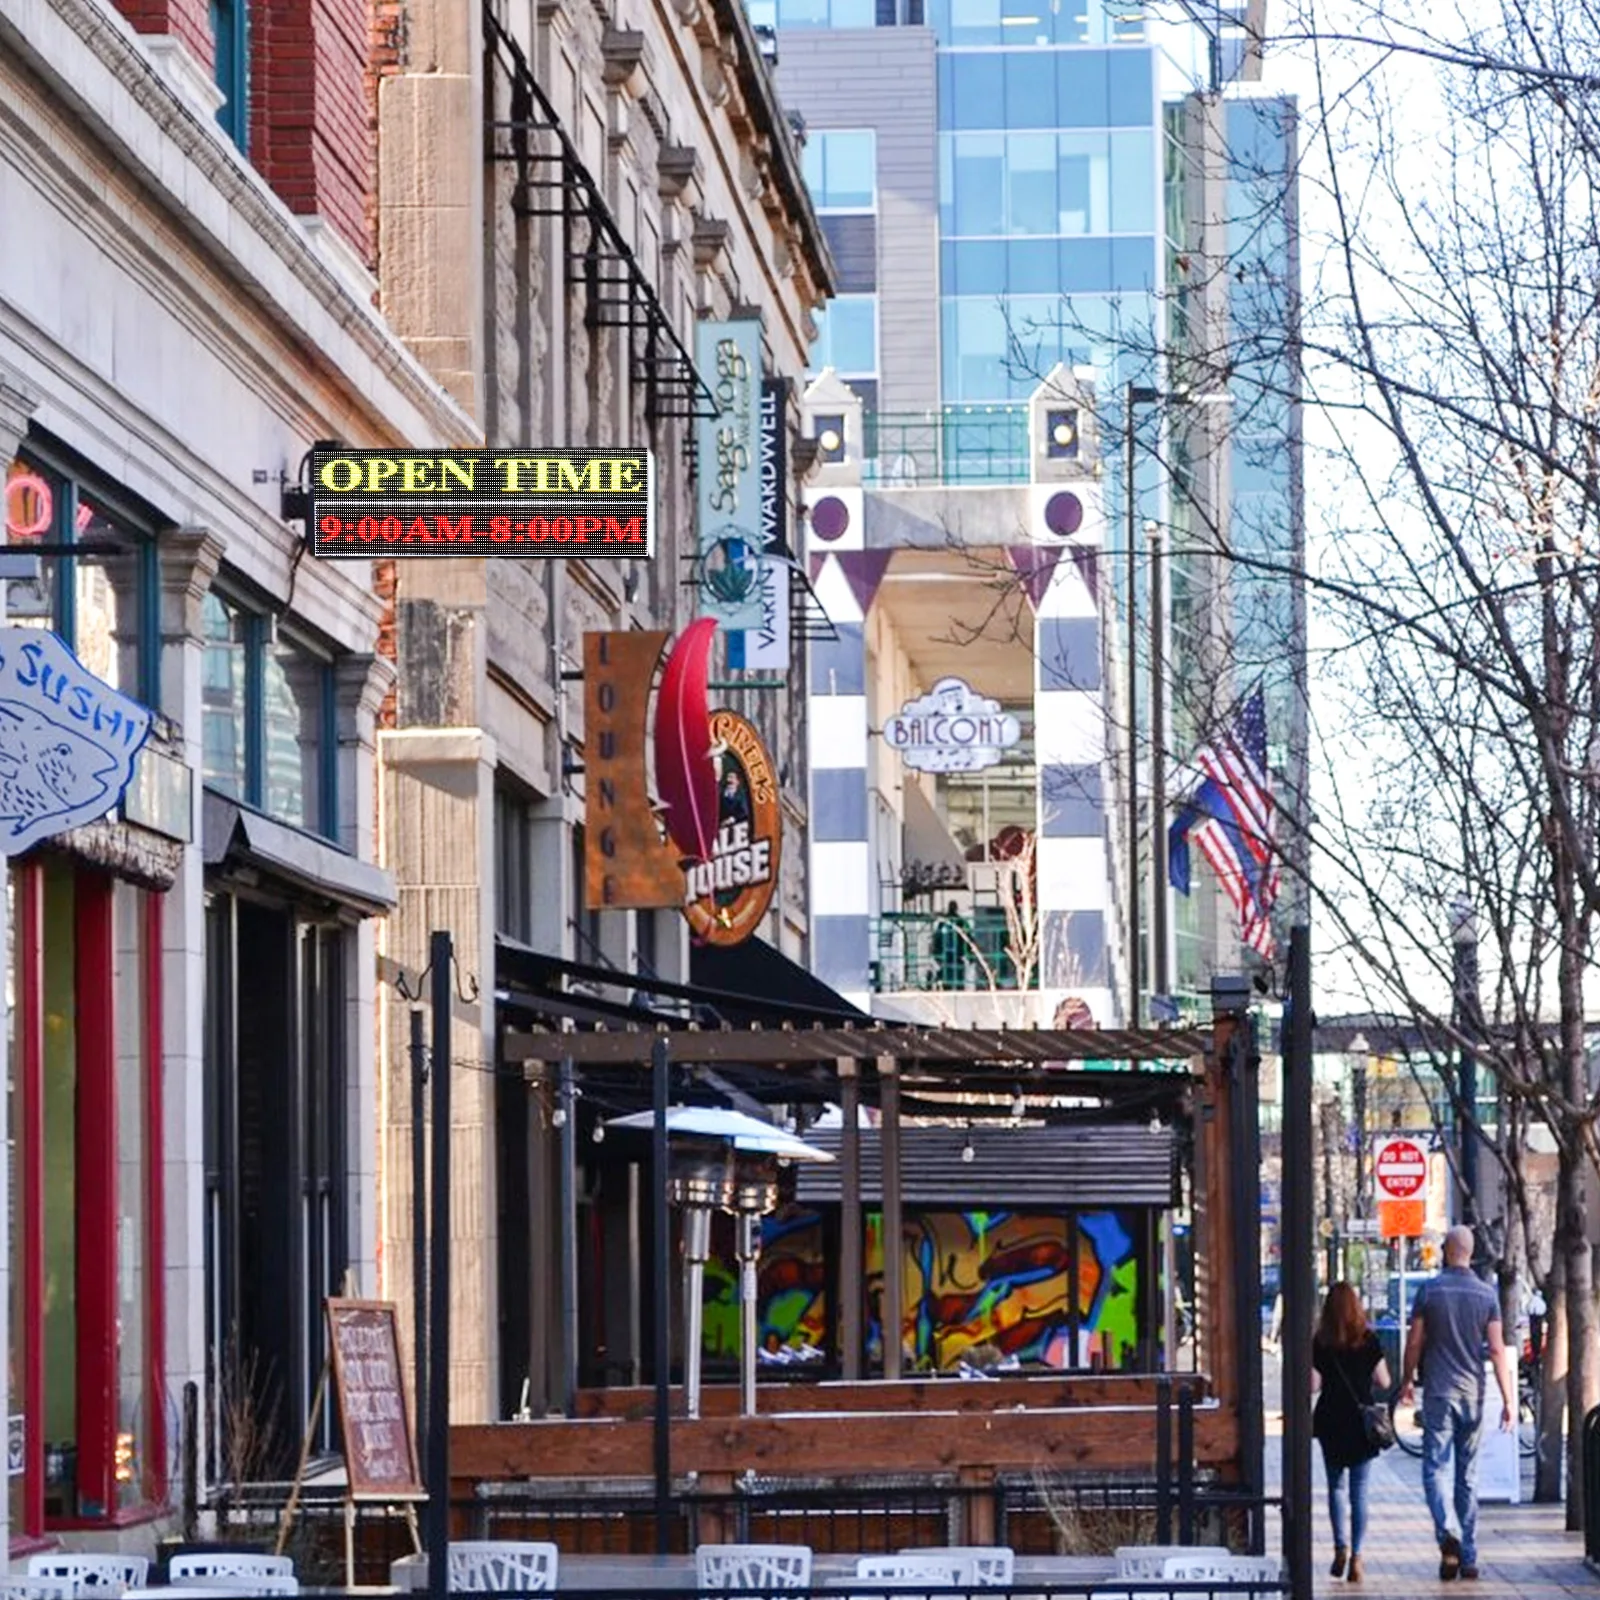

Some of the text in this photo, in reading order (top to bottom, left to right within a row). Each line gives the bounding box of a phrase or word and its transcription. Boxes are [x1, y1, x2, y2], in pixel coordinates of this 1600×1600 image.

[709, 338, 748, 515] Sage Yoga
[319, 458, 643, 493] OPEN TIME
[761, 391, 776, 545] WARDWELL
[319, 515, 644, 544] 9:00AM-8:00PM
[15, 643, 136, 747] SUSHI
[894, 718, 1008, 745] BALCONY
